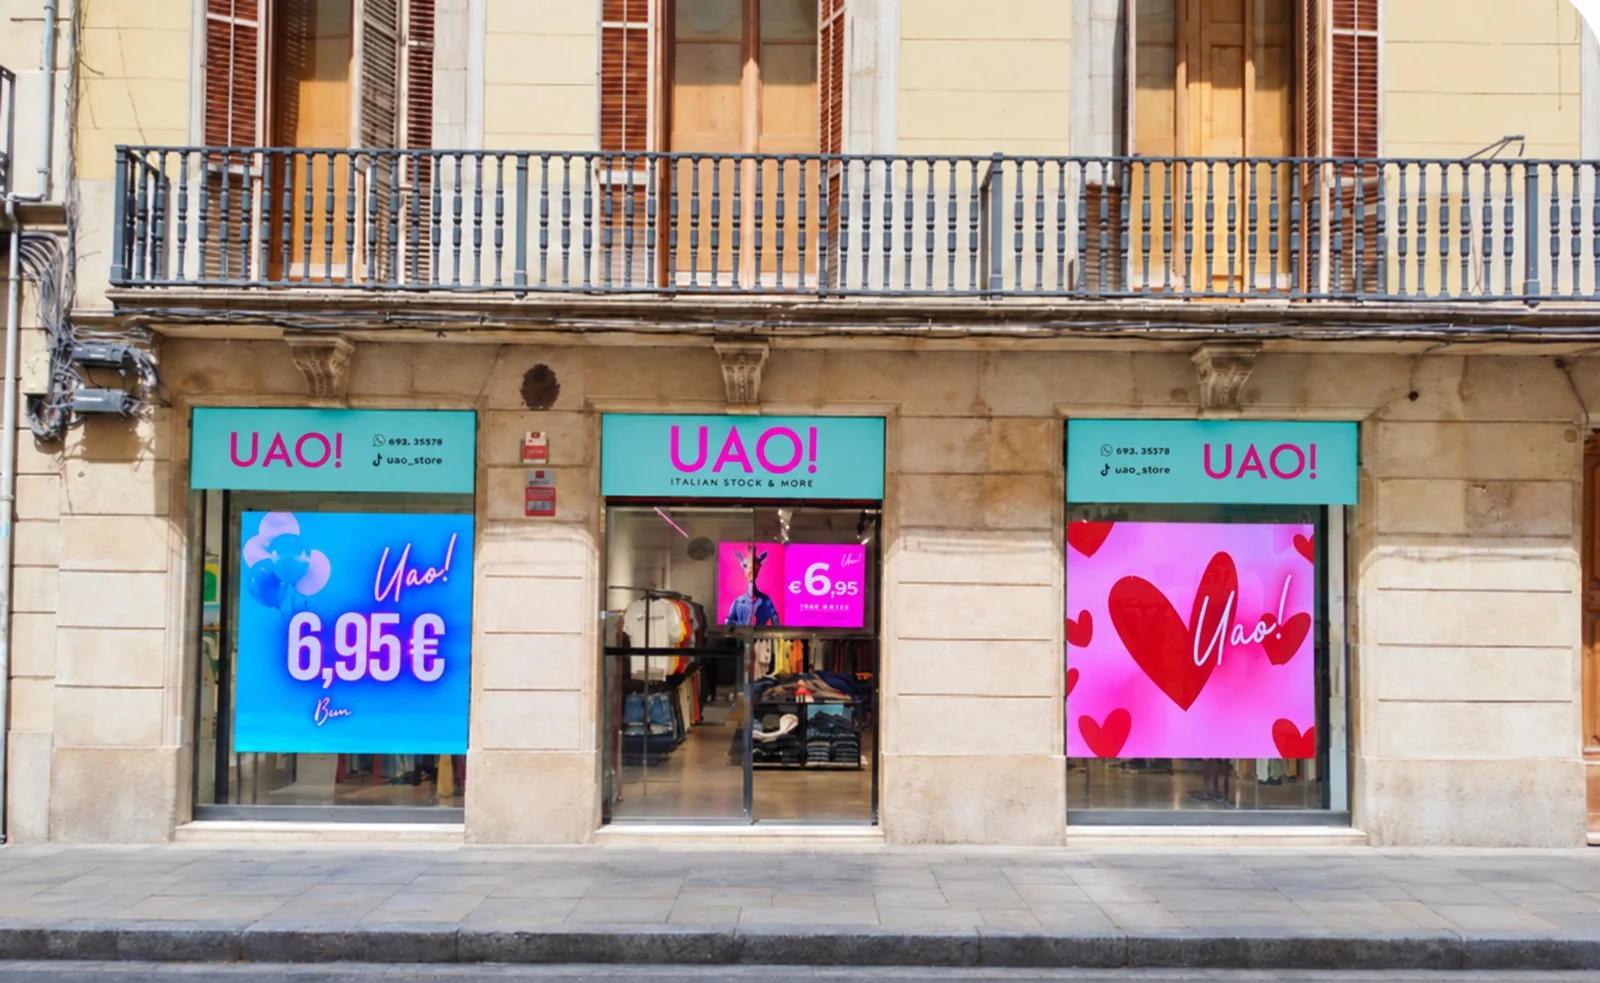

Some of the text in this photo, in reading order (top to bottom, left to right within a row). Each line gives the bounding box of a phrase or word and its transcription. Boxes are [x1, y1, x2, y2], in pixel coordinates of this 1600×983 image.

[229, 431, 343, 468] UAO!
[387, 456, 443, 466] uao_store
[670, 424, 818, 474] UAO!
[1203, 443, 1317, 480] UAO!
[670, 477, 814, 488] ITALIAN STOCK & MORE
[1115, 466, 1170, 475] uao_store
[374, 532, 457, 602] Uao!
[841, 552, 862, 568] U!
[1193, 573, 1292, 667] Uao!
